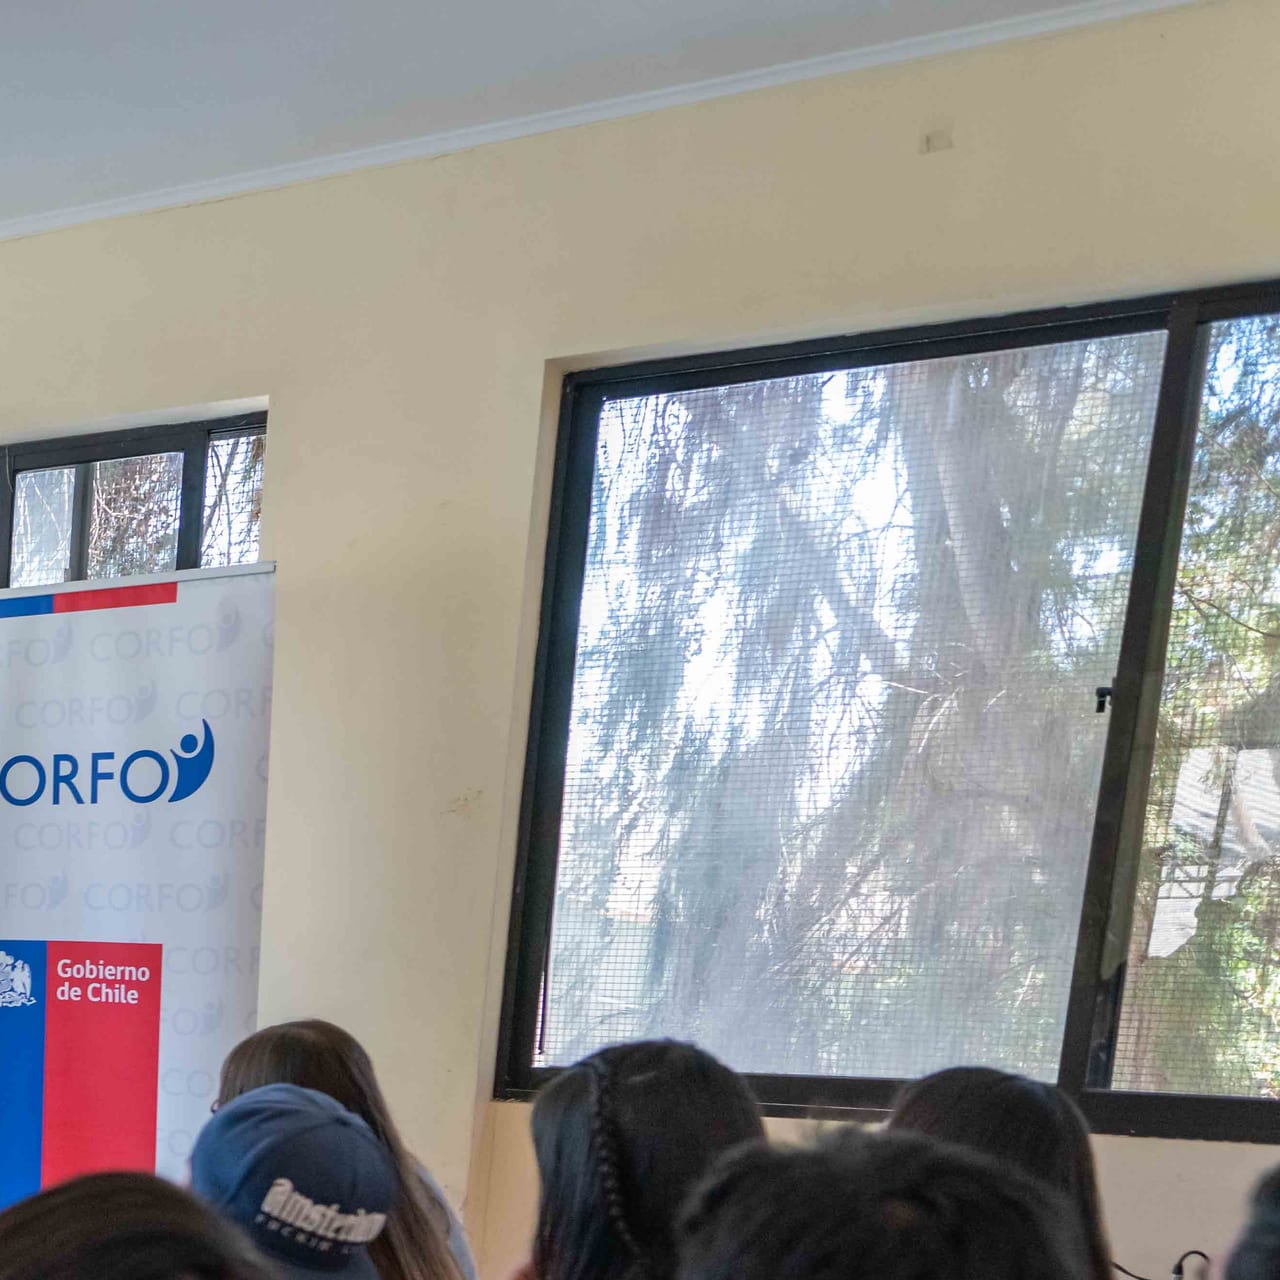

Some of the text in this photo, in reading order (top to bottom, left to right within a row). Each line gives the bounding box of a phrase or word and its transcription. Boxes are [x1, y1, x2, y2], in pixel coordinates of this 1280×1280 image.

[91, 623, 214, 663] CORFO
[14, 693, 133, 729] CORFO
[13, 820, 129, 851] CORFO
[83, 881, 205, 912] CORFO
[57, 959, 150, 982] Gobierno
[56, 982, 139, 1005] de Chile
